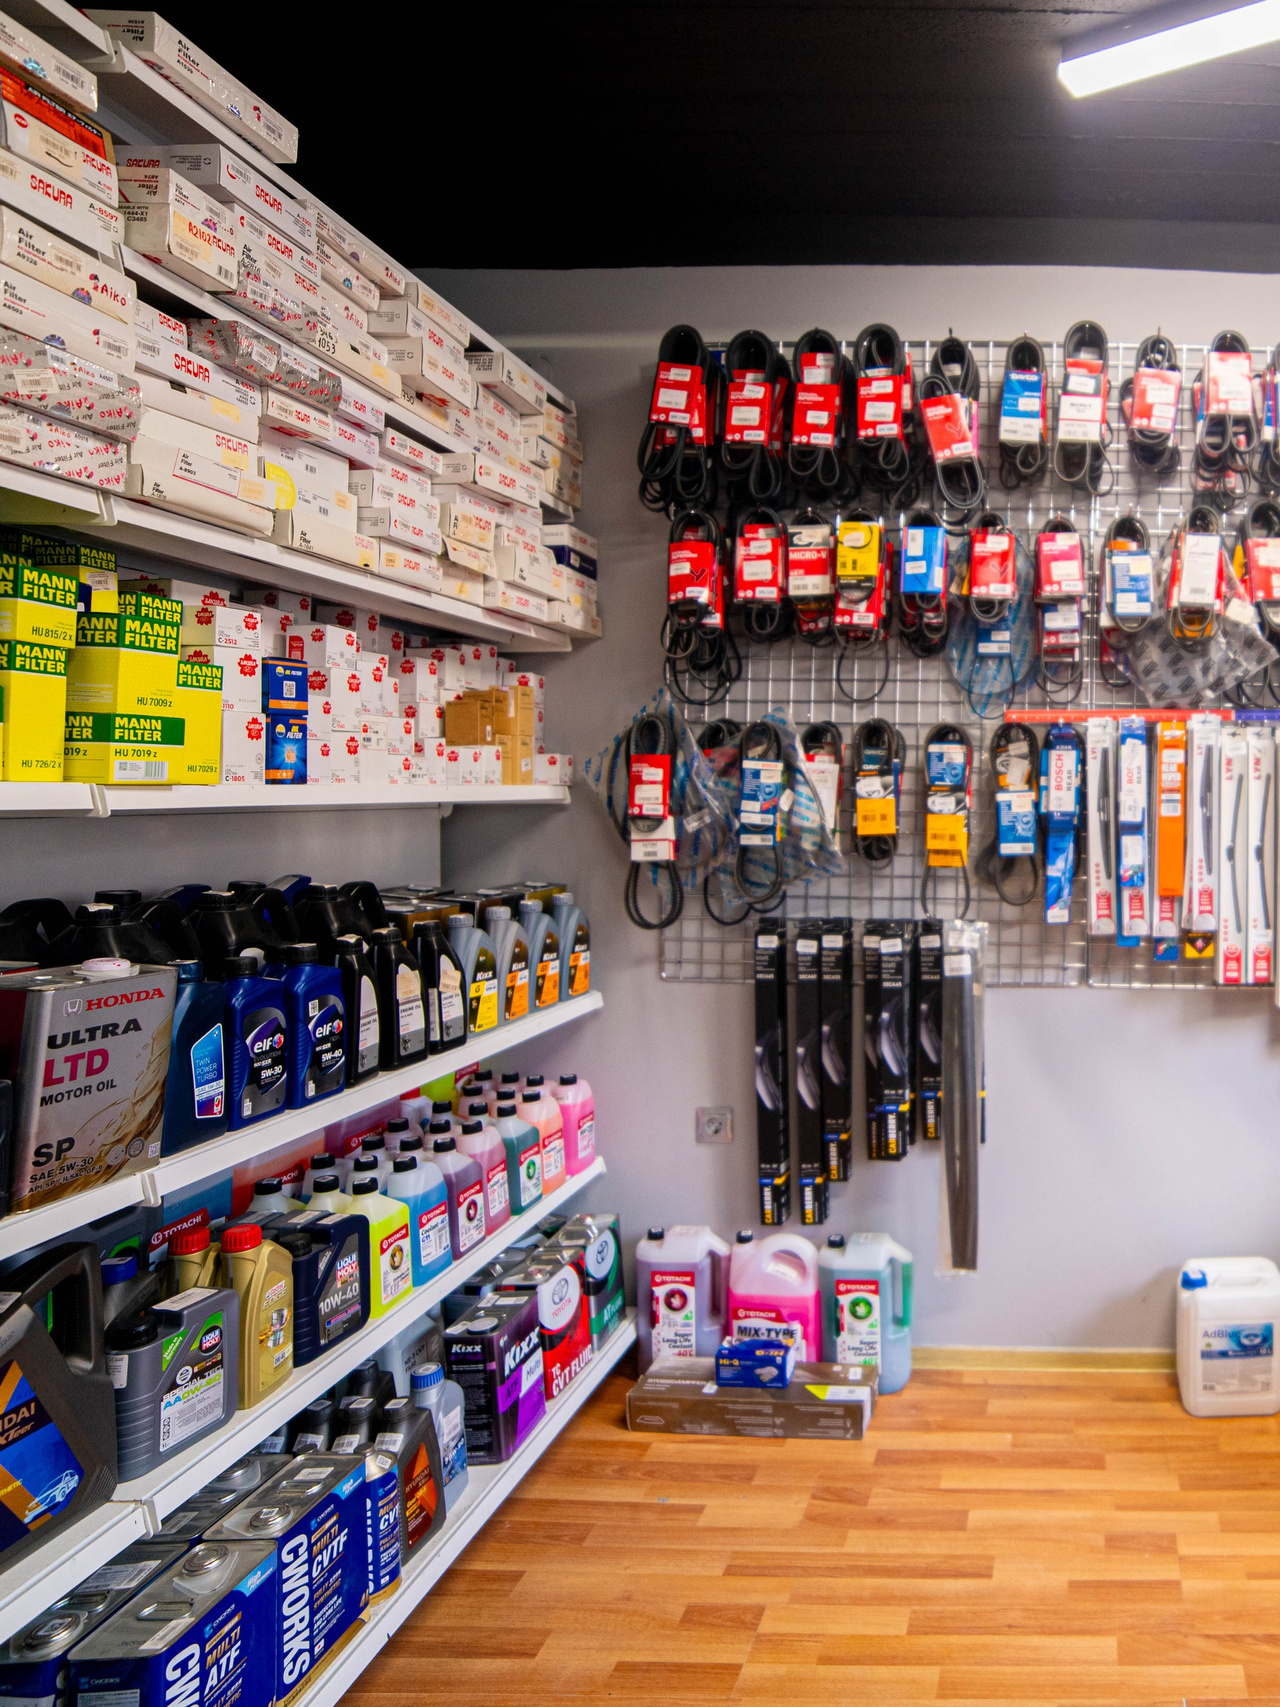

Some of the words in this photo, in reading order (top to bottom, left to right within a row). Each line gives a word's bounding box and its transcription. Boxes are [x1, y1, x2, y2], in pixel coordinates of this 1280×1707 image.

[177, 39, 190, 52] Air
[177, 47, 200, 68] Filter
[30, 174, 73, 210] SAKURA
[255, 184, 282, 214] SAKURA
[18, 227, 33, 241] Air
[18, 236, 47, 257] Filter
[243, 244, 252, 253] Air
[267, 233, 293, 261] SAKURA
[317, 238, 325, 248] Air
[242, 250, 257, 264] Filter
[317, 245, 331, 260] Filter
[4, 281, 17, 292] Air
[294, 272, 318, 297] SAKURA
[4, 288, 27, 305] Filter
[101, 283, 127, 307] Aiko
[159, 313, 184, 336] SAKURA
[174, 353, 210, 383] SAKURA
[215, 435, 248, 455] SAKURA
[181, 459, 192, 467] Filter
[81, 547, 116, 562] MANN
[789, 551, 827, 559] MICRO-V
[81, 556, 116, 571] FILTER
[23, 569, 76, 593] MANN
[22, 583, 76, 606] FILTER
[141, 595, 182, 613] MANN
[141, 606, 181, 623] FILTER
[32, 626, 43, 636] HU
[44, 627, 67, 641] 815/2
[125, 619, 178, 638] MANN
[124, 633, 177, 651] FILTER
[15, 644, 66, 661] MANN
[15, 657, 65, 673] FILTER
[179, 663, 222, 678] MANN
[178, 674, 221, 688] FILTER
[137, 697, 147, 706] HU
[149, 697, 168, 707] 7009
[115, 717, 161, 730] MANN
[114, 730, 161, 742] FILTER
[115, 749, 129, 757] HU
[131, 749, 151, 757] 7019
[22, 760, 33, 768] HU
[35, 760, 56, 769] 726/2
[198, 765, 213, 773] 7029
[1055, 754, 1064, 791] BOSCH
[1162, 763, 1178, 771] REAR
[1162, 773, 1182, 781] WIPER
[575, 944, 587, 952] Kixx
[543, 952, 557, 961] Kixx
[512, 962, 525, 971] Kixx
[476, 971, 493, 981] Kixx
[85, 988, 165, 1011] HONDA
[47, 1018, 142, 1049] ULTRA
[316, 1022, 332, 1037] elf
[254, 1037, 272, 1052] elf
[196, 1058, 210, 1067] TWIN
[322, 1049, 342, 1062] 5W-40
[42, 1048, 110, 1088] LTD
[196, 1063, 217, 1074] POWER
[261, 1065, 282, 1078] 5W-30
[197, 1071, 217, 1082] TURBO
[40, 1085, 93, 1107] MOTOR
[96, 1079, 117, 1093] OIL
[32, 1137, 75, 1167] SP
[29, 1169, 55, 1184] SAE
[58, 1157, 94, 1175] 5W-30
[28, 1185, 43, 1194] API
[45, 1180, 55, 1190] SP
[427, 1206, 445, 1220] TOTACHI
[164, 1214, 202, 1238] TOTACHI
[388, 1228, 406, 1244] TOTACHI
[337, 1253, 357, 1269] LIQUI
[337, 1263, 357, 1279] MOLY
[263, 1288, 287, 1309] EDGE
[319, 1282, 359, 1315] 10W-40
[552, 1298, 571, 1319] TOYOTA
[604, 1303, 611, 1324] AT
[202, 1330, 219, 1342] LIQUI
[737, 1326, 797, 1339] MIX-TYPE
[1203, 1329, 1241, 1339] AdBlue
[202, 1337, 219, 1350] MOLY
[451, 1344, 482, 1353] Kixx
[504, 1326, 539, 1378] Kixx
[526, 1357, 541, 1381] Multi
[552, 1366, 570, 1398] CVT
[571, 1344, 592, 1378] FLUID
[506, 1378, 519, 1401] ATF
[406, 1468, 430, 1493] HYUNDAI
[312, 1523, 339, 1557] MULTI
[312, 1528, 348, 1579] CVTF
[281, 1533, 311, 1685] CWORKS
[206, 1625, 240, 1670] MULTI
[204, 1640, 241, 1697] ATF
